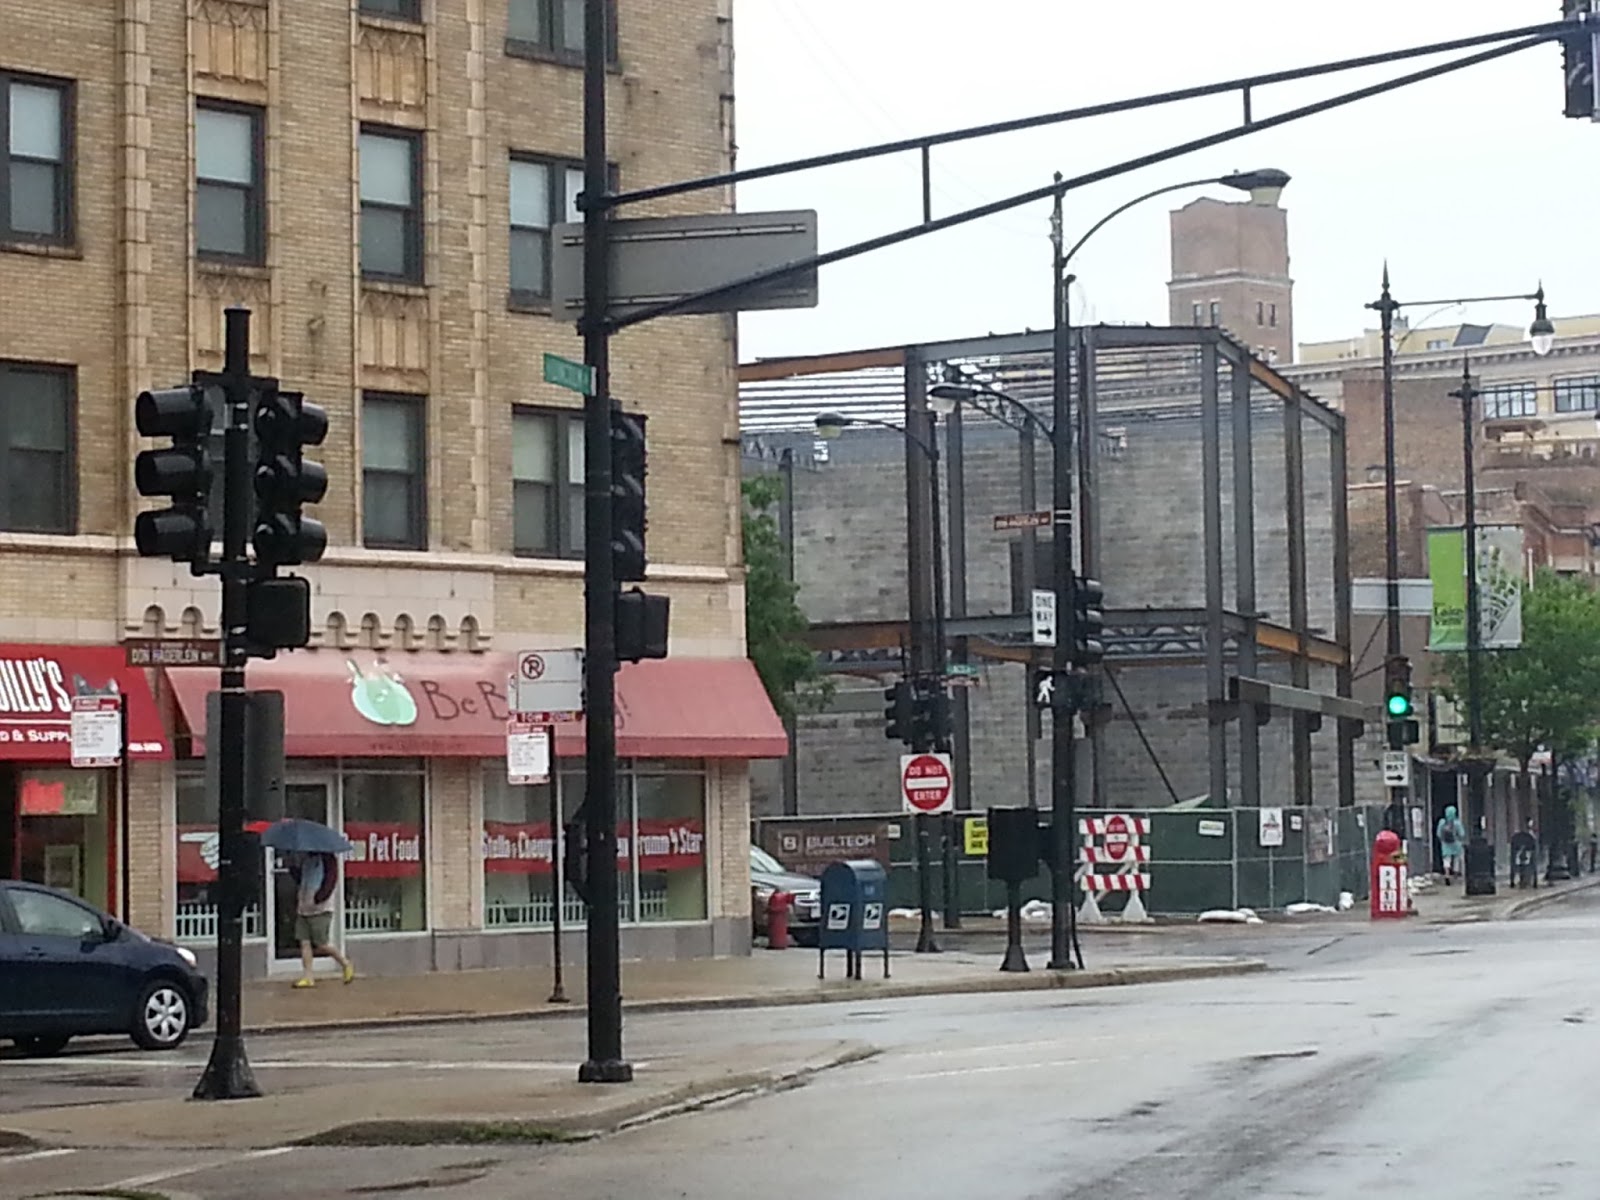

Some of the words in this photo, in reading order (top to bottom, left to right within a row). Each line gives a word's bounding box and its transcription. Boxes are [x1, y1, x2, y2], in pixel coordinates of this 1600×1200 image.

[908, 766, 922, 776] DO
[924, 764, 943, 775] NOT
[913, 789, 942, 801] ENTER
[369, 833, 390, 862] Pet
[392, 833, 420, 862] Food
[806, 834, 876, 849] BUILTECH
